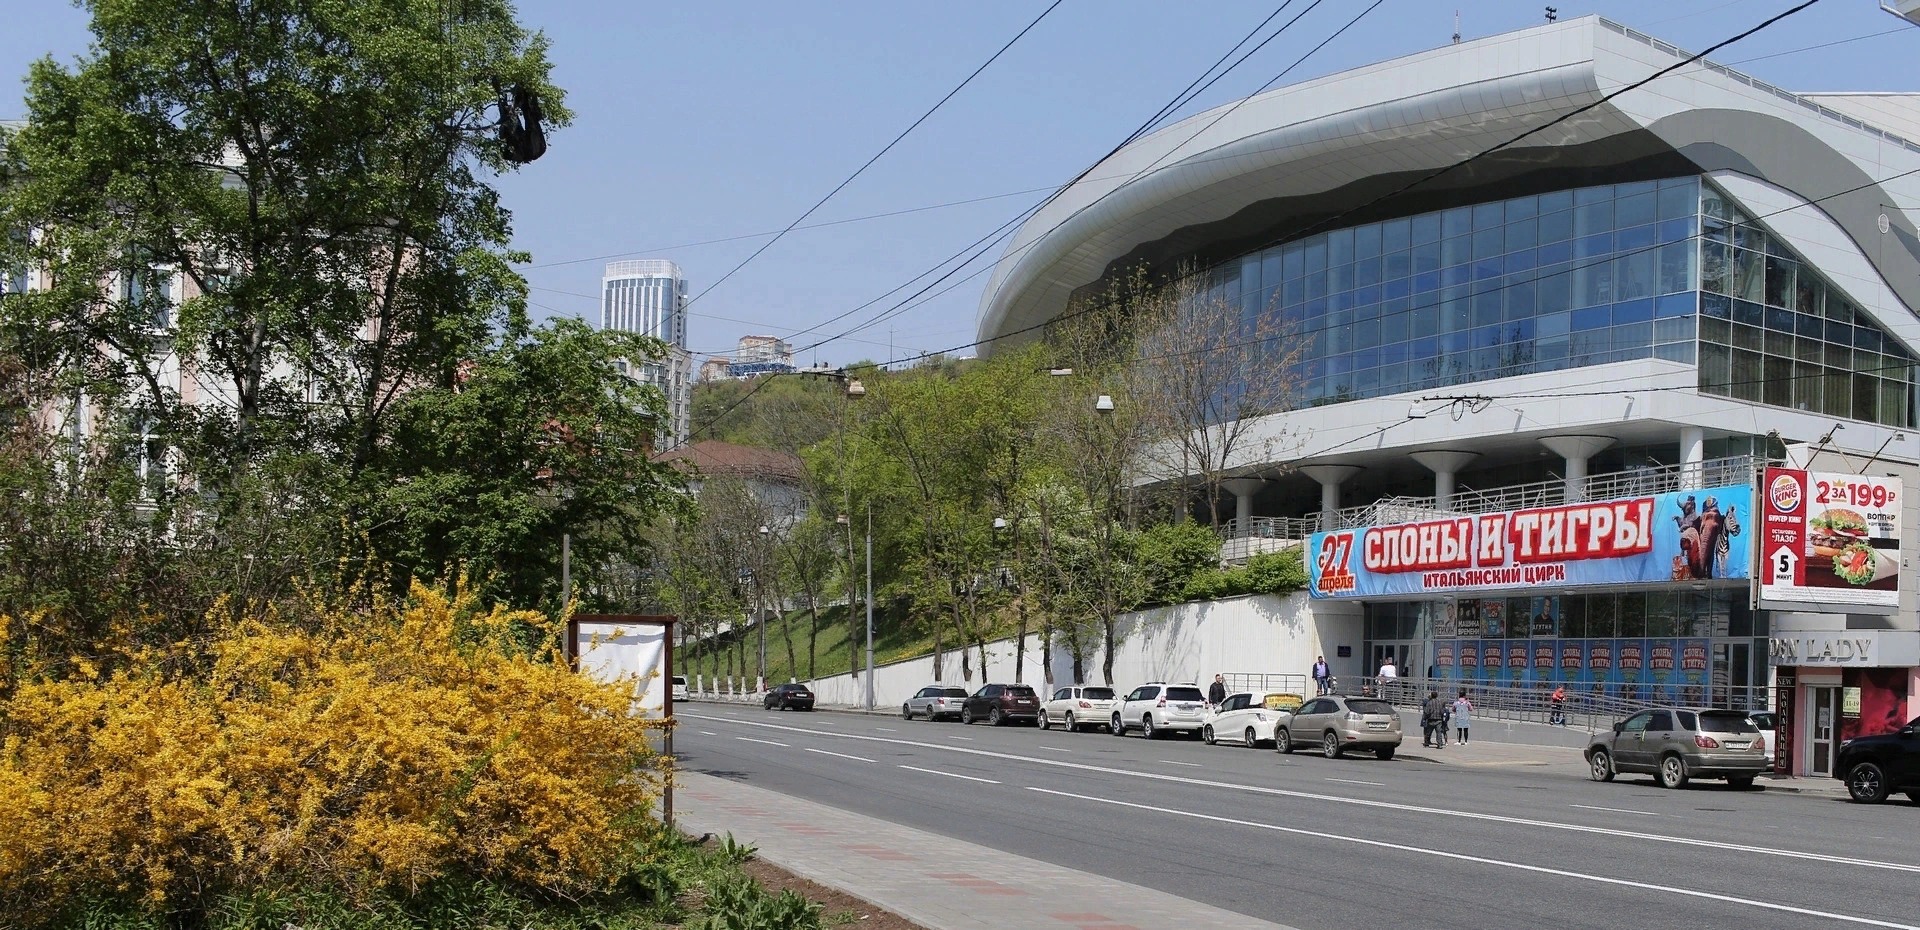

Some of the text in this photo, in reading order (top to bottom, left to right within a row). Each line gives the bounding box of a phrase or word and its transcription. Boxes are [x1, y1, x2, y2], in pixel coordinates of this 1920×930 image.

[1774, 483, 1797, 495] BURGER
[1775, 489, 1797, 503] KING
[1816, 481, 1830, 504] 2
[1831, 488, 1847, 499] ЗА
[1365, 502, 1652, 569] СЛОНЫ И ТИГРЫ
[1322, 533, 1354, 577] 27
[1779, 555, 1789, 573] 5
[1424, 564, 1564, 588] ИТАЛЬЯНСКИЙ ЦИРК
[1318, 576, 1354, 592] апреля
[1457, 628, 1480, 636] ВРЕМЕНИ
[1651, 648, 1672, 658] СЛОНЫ
[1683, 648, 1705, 658] СЛОНЫ
[1806, 638, 1871, 660] LADY
[1686, 659, 1706, 669] ТИГРЫ
[1777, 678, 1793, 686] NEW
